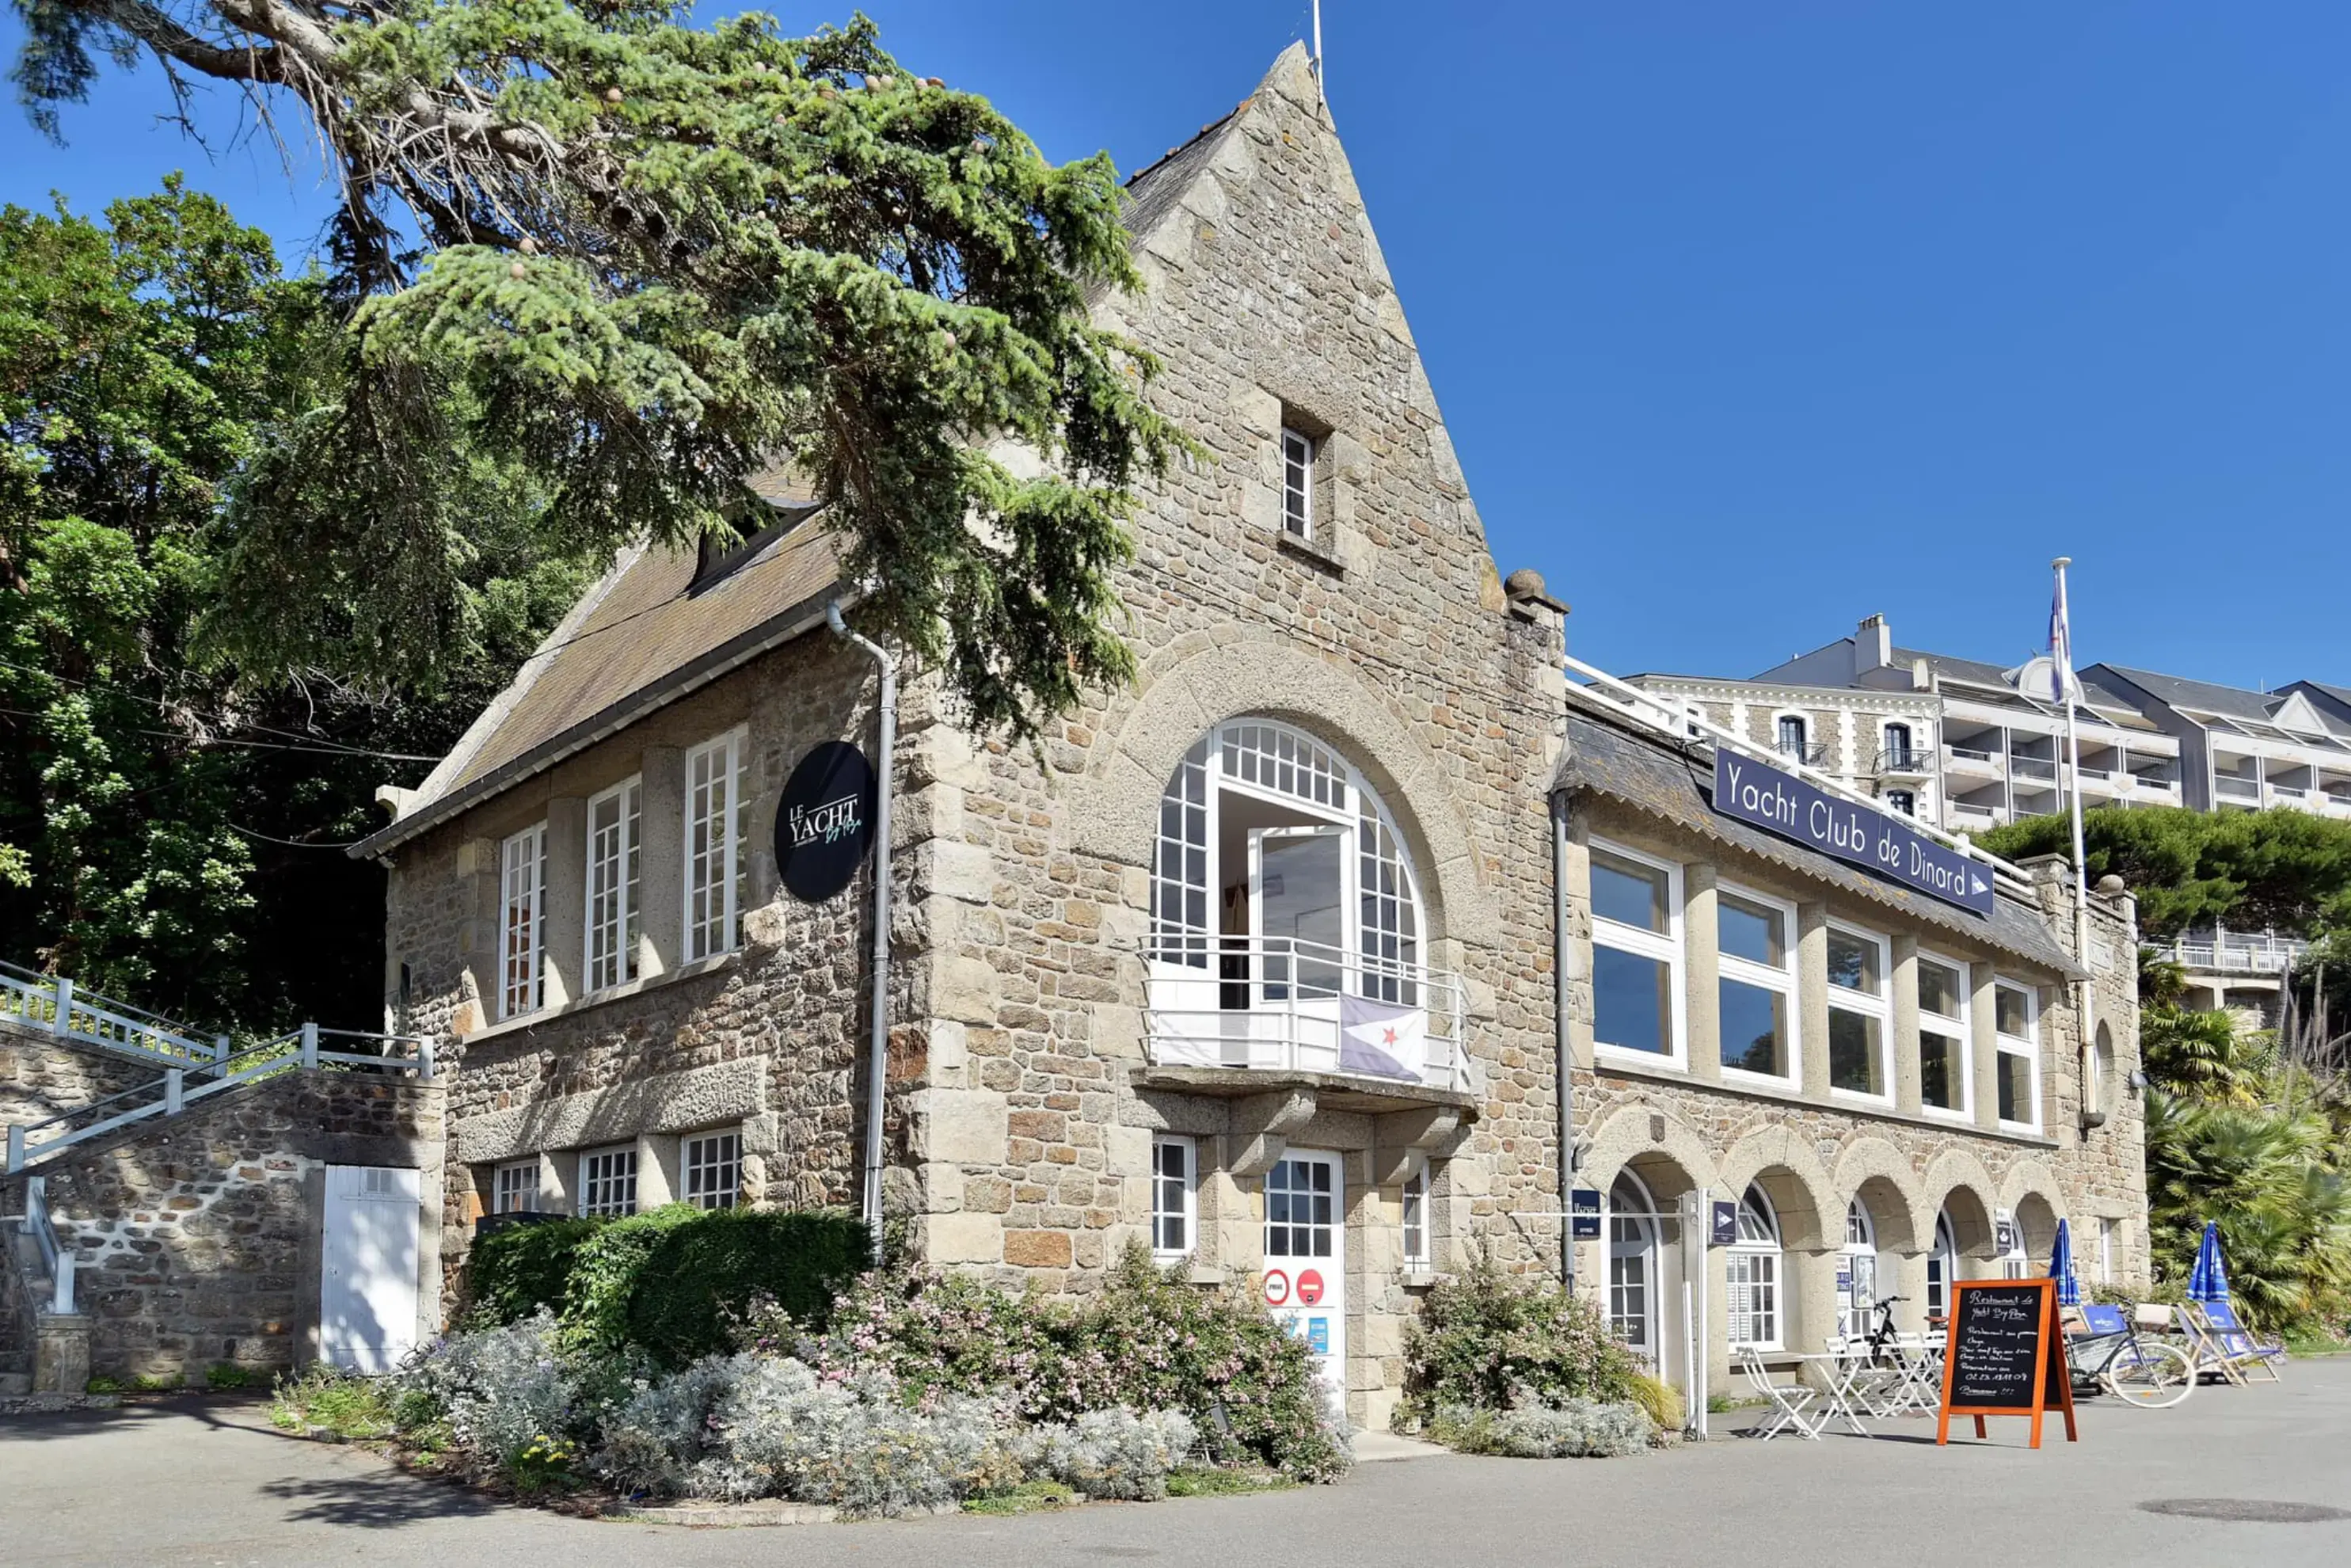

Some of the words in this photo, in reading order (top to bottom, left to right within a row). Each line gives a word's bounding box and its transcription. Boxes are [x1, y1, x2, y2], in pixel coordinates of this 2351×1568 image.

[789, 804, 805, 822] LE
[789, 798, 858, 843] YACHT
[1727, 761, 1798, 827] Yacht
[1809, 800, 1866, 853] Club
[1877, 828, 1900, 868] de
[1910, 840, 1965, 896] Dinard
